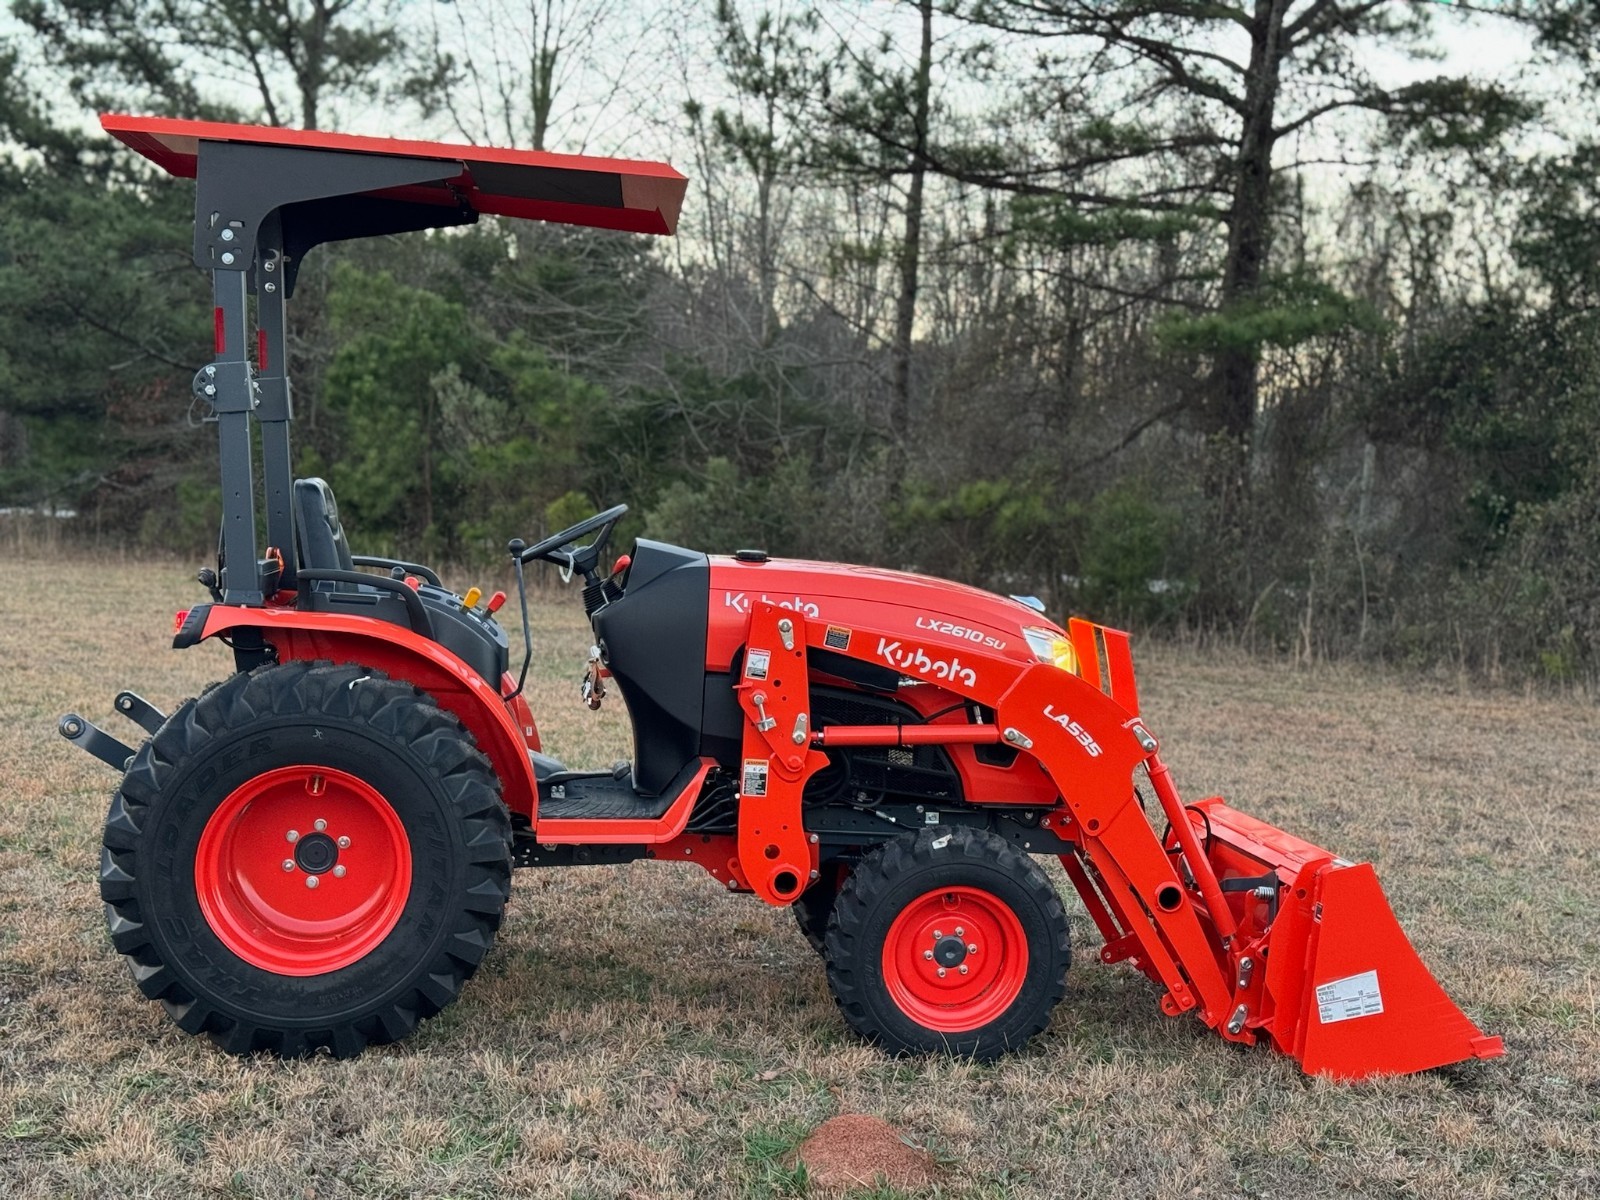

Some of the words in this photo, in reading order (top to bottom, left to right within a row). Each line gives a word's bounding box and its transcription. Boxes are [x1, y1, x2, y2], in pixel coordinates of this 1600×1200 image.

[876, 637, 977, 688] Kubota
[1043, 704, 1104, 758] LA535
[158, 735, 275, 883] LOADER
[415, 811, 449, 945] TITAN
